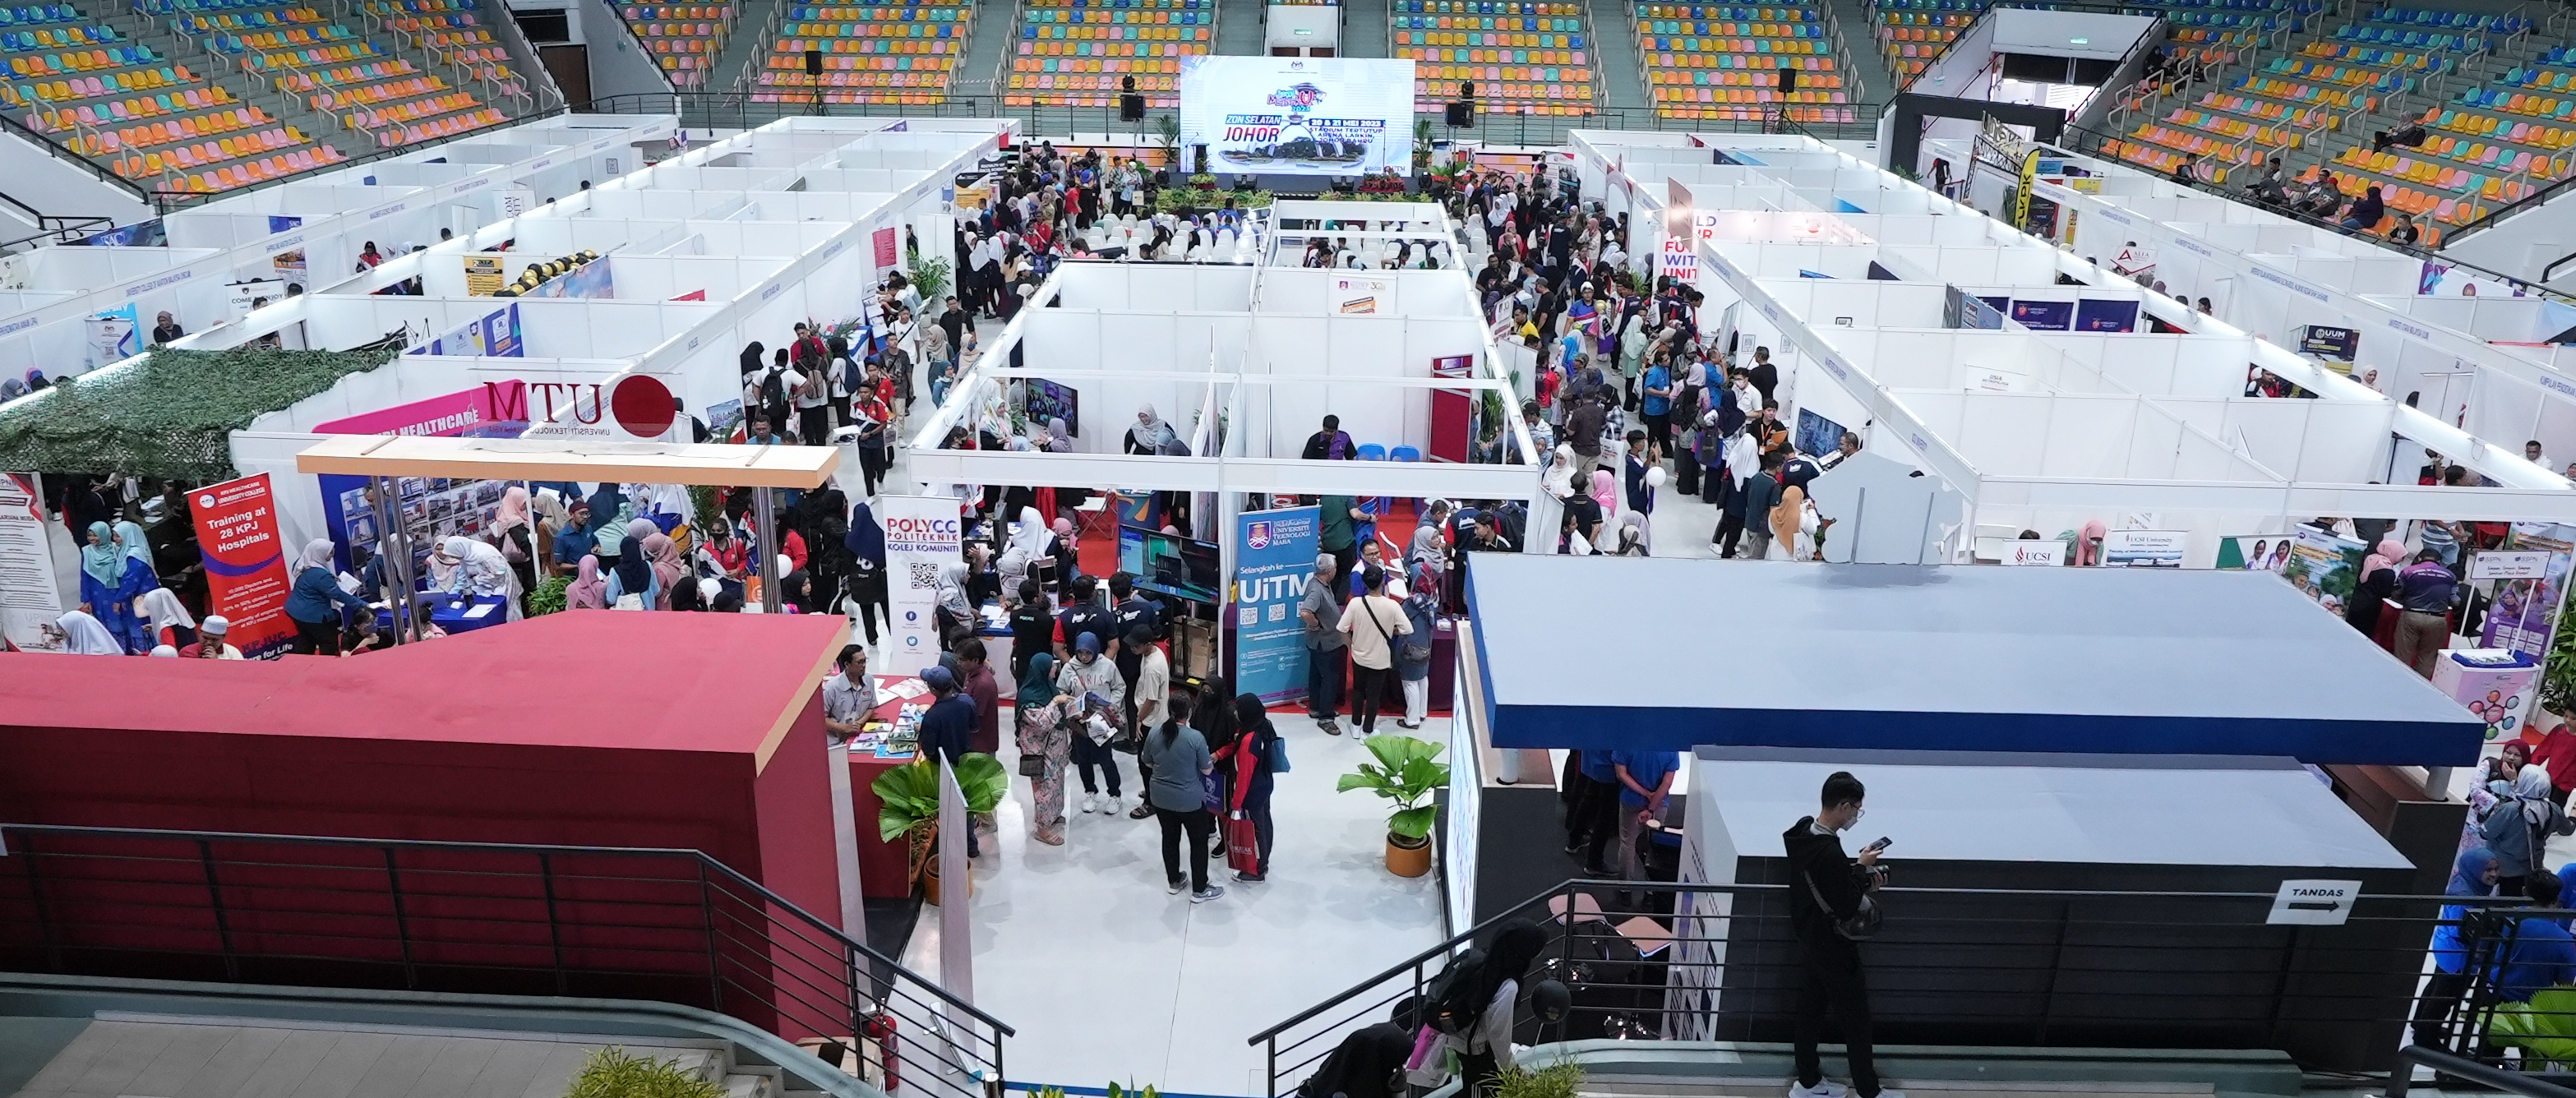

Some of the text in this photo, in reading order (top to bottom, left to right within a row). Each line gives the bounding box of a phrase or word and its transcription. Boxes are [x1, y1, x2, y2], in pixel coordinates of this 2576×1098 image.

[1226, 115, 1282, 124] ZON SELATAN
[1222, 127, 1280, 142] JOHOR
[2324, 330, 2346, 338] UUM
[399, 409, 480, 436] HEALTHCARE
[206, 506, 266, 529] Training at
[219, 521, 258, 539] 28 KPJ
[887, 518, 957, 533] POLYCC
[218, 532, 270, 553] Hospitals
[888, 533, 958, 542] POLITEKNIK
[888, 543, 959, 552] KOLEJ KOMUNITI
[2025, 551, 2051, 561] UCSI
[1240, 564, 1276, 574] Selangkah
[1240, 571, 1314, 603] UiTM
[263, 649, 275, 659] for
[277, 643, 293, 654] Life
[2292, 888, 2344, 897] TANDAS
